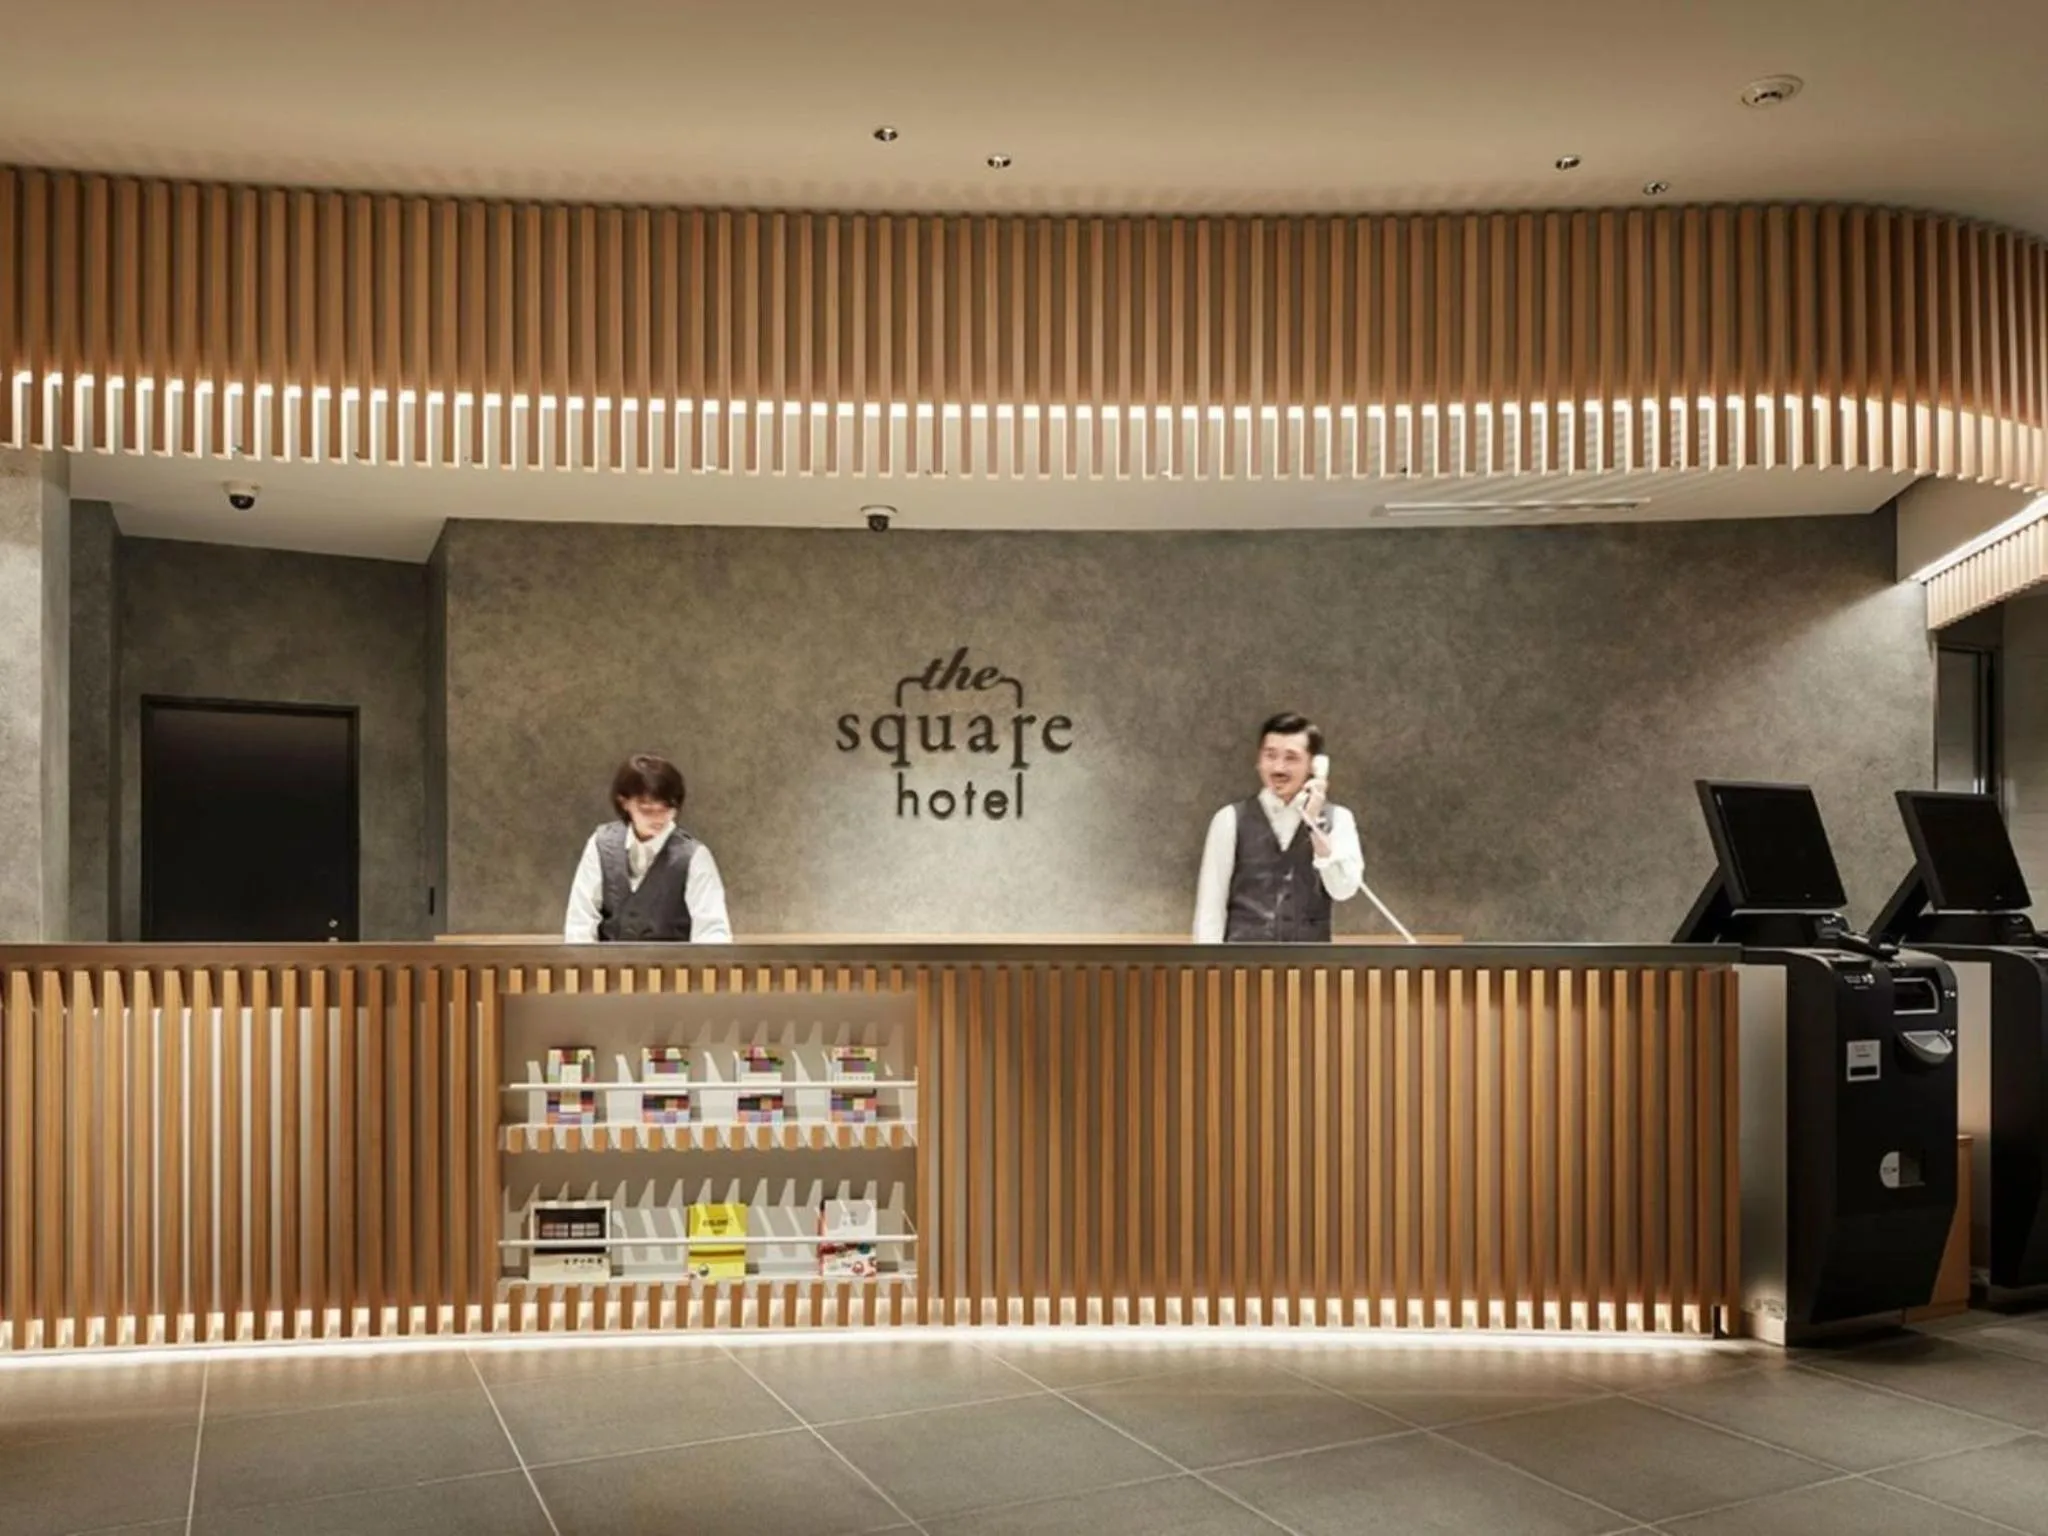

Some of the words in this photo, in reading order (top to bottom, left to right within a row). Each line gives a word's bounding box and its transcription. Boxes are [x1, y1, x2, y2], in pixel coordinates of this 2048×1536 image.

[919, 646, 1002, 691] the
[835, 712, 1073, 770] square
[896, 771, 1023, 820] hotel
